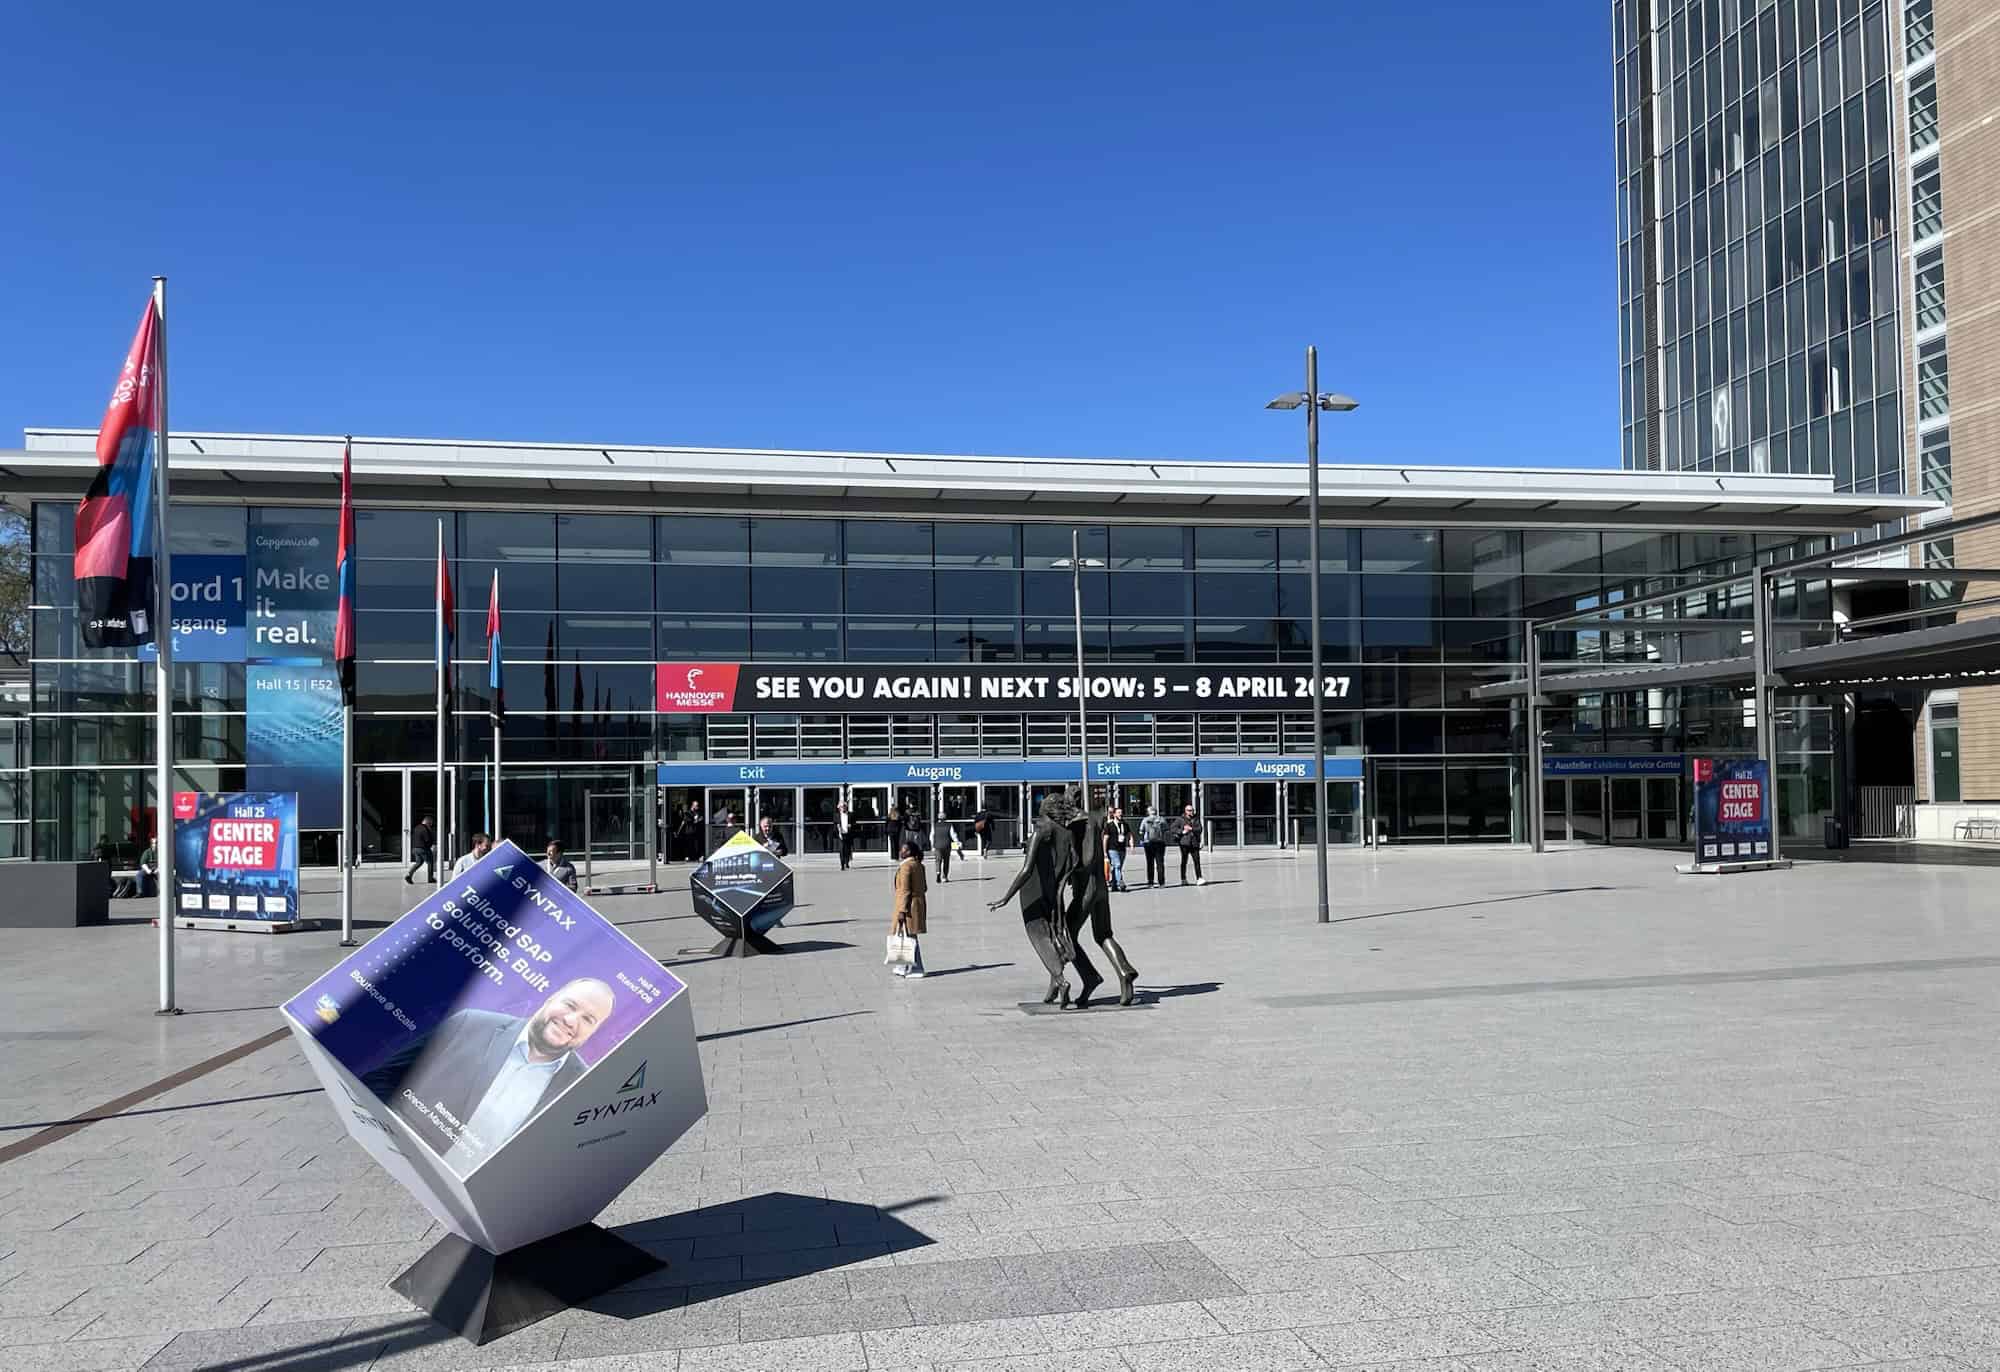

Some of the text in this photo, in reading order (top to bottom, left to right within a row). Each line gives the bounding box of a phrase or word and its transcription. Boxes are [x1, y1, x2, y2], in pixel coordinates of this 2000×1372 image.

[256, 536, 309, 550] Capgemini
[171, 576, 243, 601] ord 1
[256, 568, 330, 590] Make
[256, 595, 276, 618] it
[171, 616, 227, 635] sgang
[256, 620, 317, 644] real.
[256, 679, 281, 690] Hall
[286, 679, 301, 690] 15
[311, 679, 333, 690] F52
[756, 676, 800, 698] SEE
[807, 677, 864, 699] YOU
[873, 676, 971, 699] AGAIN!
[981, 677, 1049, 698] NEXT
[1057, 677, 1145, 698] SHOW:
[1153, 677, 1167, 698] 5
[1196, 677, 1212, 698] 8
[1217, 677, 1288, 698] APRIL
[665, 692, 725, 700] HANNOVER
[676, 699, 715, 707] MESSE
[739, 767, 766, 779] Exit
[907, 764, 962, 780] Ausgang
[1097, 763, 1121, 775] Exit
[1254, 762, 1306, 776] Ausgang
[1722, 783, 1760, 799] CENTER
[235, 806, 265, 818] Hall 25
[1723, 802, 1753, 818] STAGE
[213, 822, 275, 842] CENTER
[213, 845, 264, 865] STAGE
[511, 876, 577, 931] SYNTAX
[460, 885, 553, 963] Tailored SAP
[425, 911, 504, 985] to perform.
[442, 900, 551, 993] solutions. Built
[350, 968, 387, 1004] Boutique
[392, 1007, 417, 1031] Scale
[573, 1089, 664, 1126] SYNTAX
